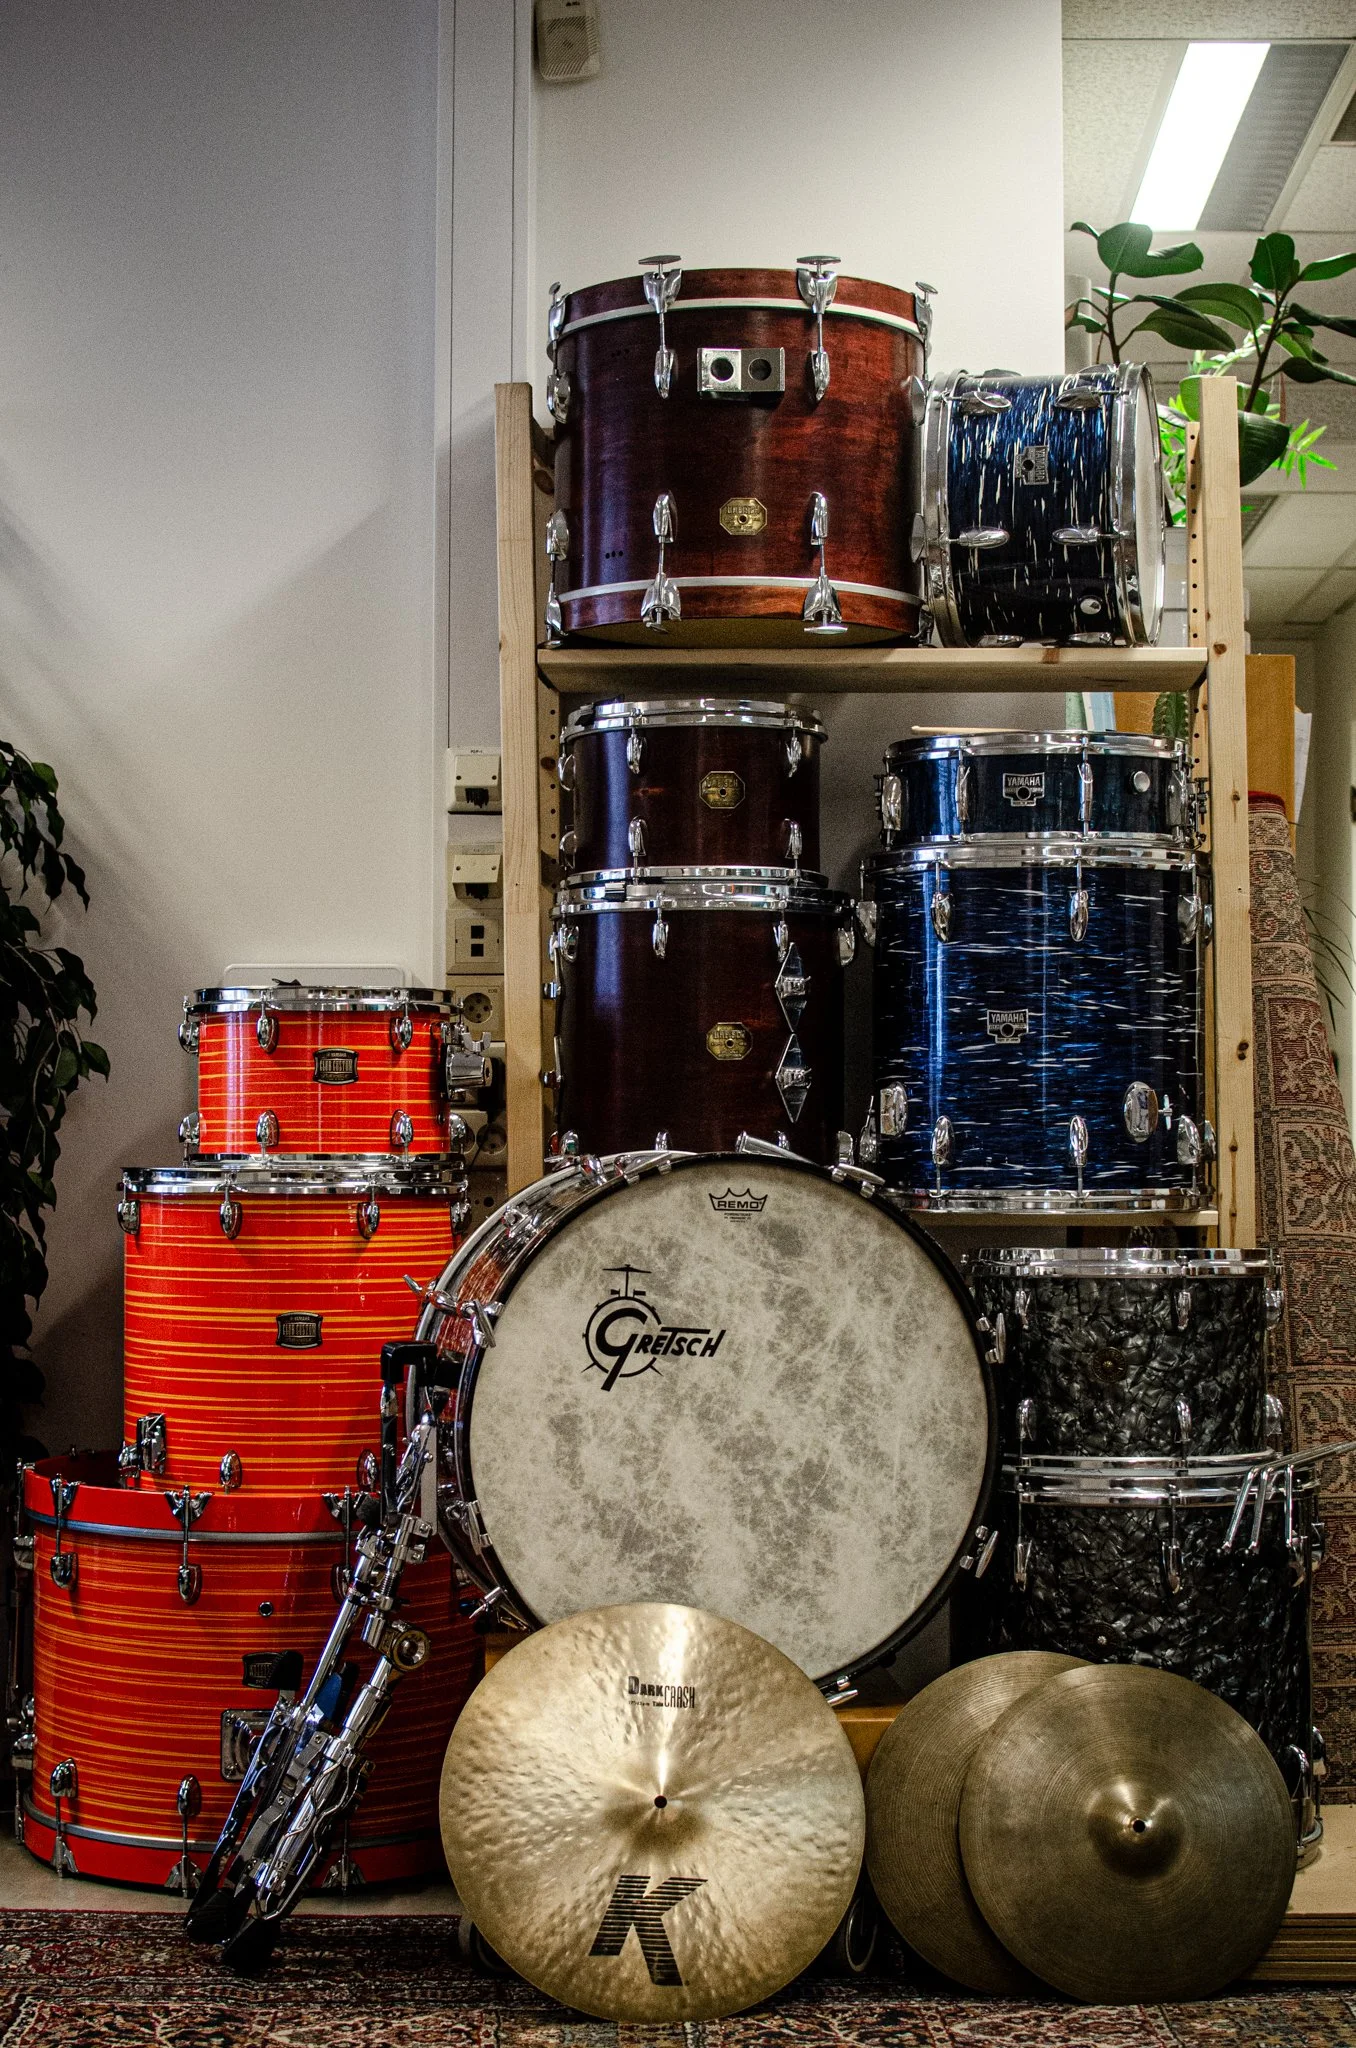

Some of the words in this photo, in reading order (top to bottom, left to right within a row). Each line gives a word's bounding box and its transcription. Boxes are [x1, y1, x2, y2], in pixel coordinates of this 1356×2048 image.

[1007, 776, 1041, 786] YAMAHA
[991, 1013, 1025, 1023] YAMAHA
[717, 1200, 759, 1209] REMO
[595, 1307, 727, 1392] GRETSCH
[628, 1675, 664, 1697] DARK
[664, 1685, 696, 1709] CRASH
[588, 1874, 709, 1987] K
